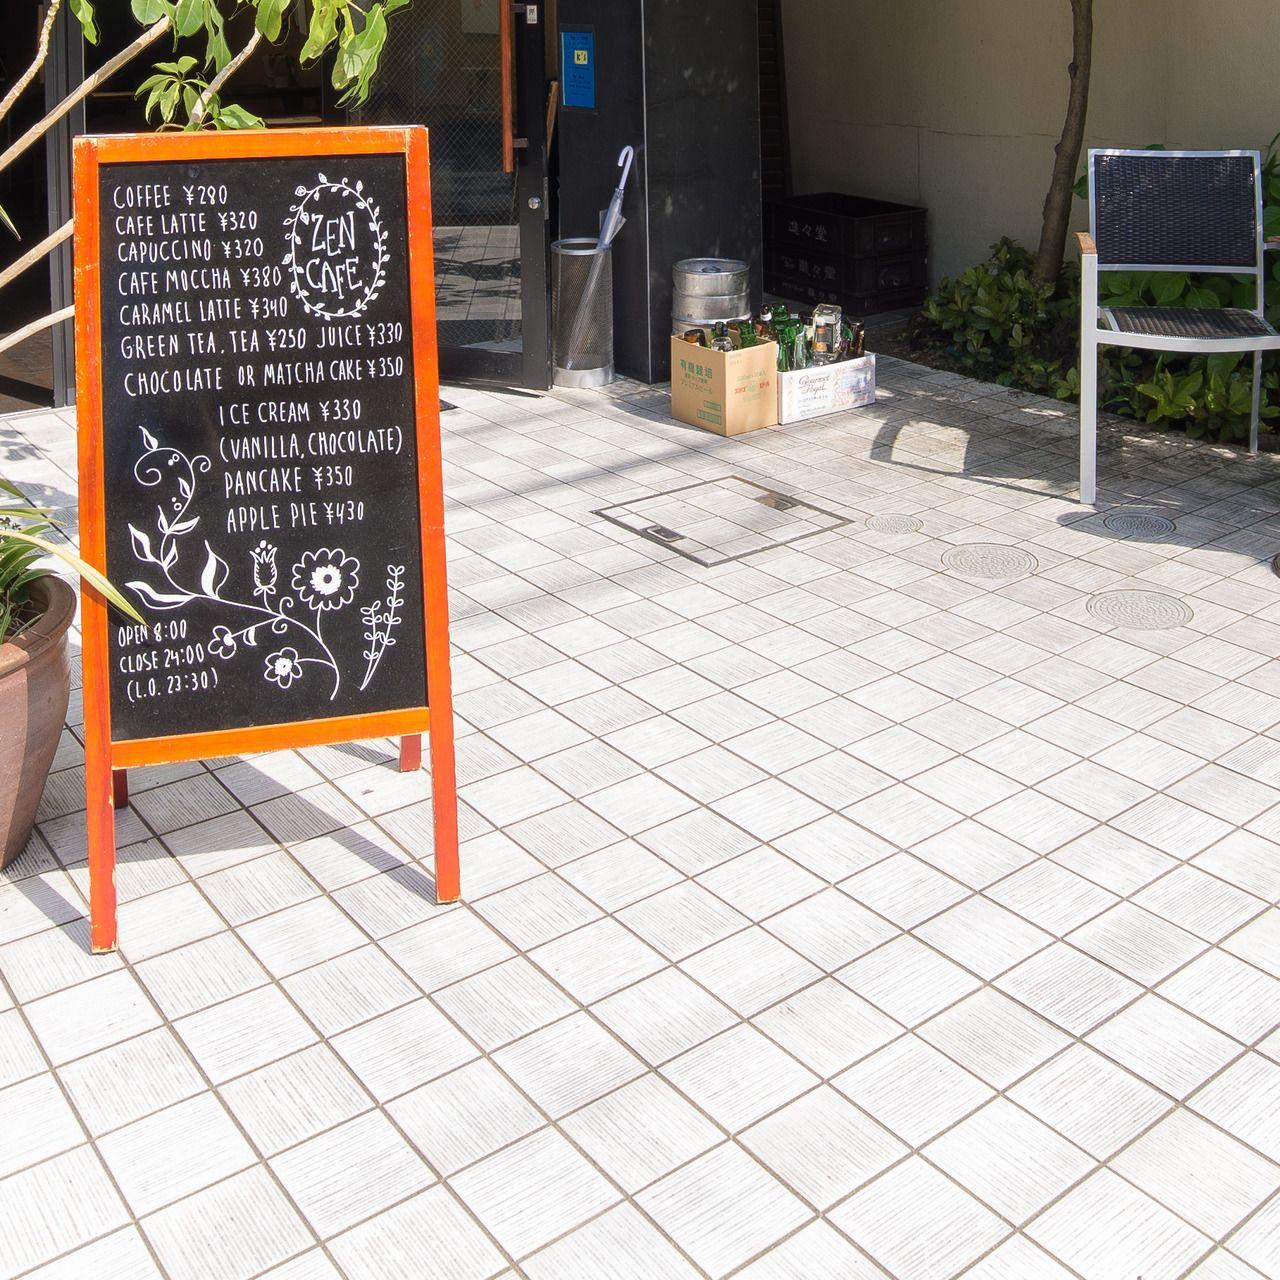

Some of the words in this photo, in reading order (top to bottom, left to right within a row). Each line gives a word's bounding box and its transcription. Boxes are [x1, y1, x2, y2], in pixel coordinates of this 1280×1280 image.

[113, 184, 171, 210] COFFEE
[182, 184, 228, 206] ¥280
[115, 215, 154, 237] CAFE
[160, 212, 206, 235] LATTE
[217, 209, 258, 232] ¥320
[310, 210, 356, 257] ZEN
[117, 238, 211, 264] CAPUCCINO
[220, 237, 264, 259] ¥320
[118, 271, 158, 296] CAFE
[165, 266, 232, 293] MOCCHA
[239, 264, 282, 288] ¥380
[306, 256, 363, 300] CAFE
[119, 301, 192, 326] CARAMEL
[199, 297, 242, 322] LATTE
[247, 295, 288, 320] ¥340
[120, 334, 179, 360] GREEN
[266, 327, 307, 352] ¥250
[316, 324, 362, 349] JUICE
[366, 321, 403, 347] ¥330
[124, 367, 223, 397] CHOCOLATE
[238, 364, 256, 387] OR
[263, 360, 325, 387] MATCHA
[329, 358, 363, 381] CAKE
[366, 355, 404, 379] ¥350
[219, 403, 250, 427] ICE
[257, 401, 310, 424] CREAM
[318, 398, 361, 422] ¥330
[224, 466, 302, 499] PANCAKE
[311, 465, 353, 491] ¥350
[226, 504, 281, 534] APPLE
[290, 503, 318, 528] PIE
[322, 500, 365, 525] ¥430
[118, 624, 149, 648] OPEN
[153, 618, 187, 643] 8:00
[119, 650, 159, 674] CLOSE
[163, 642, 205, 668] 24:00
